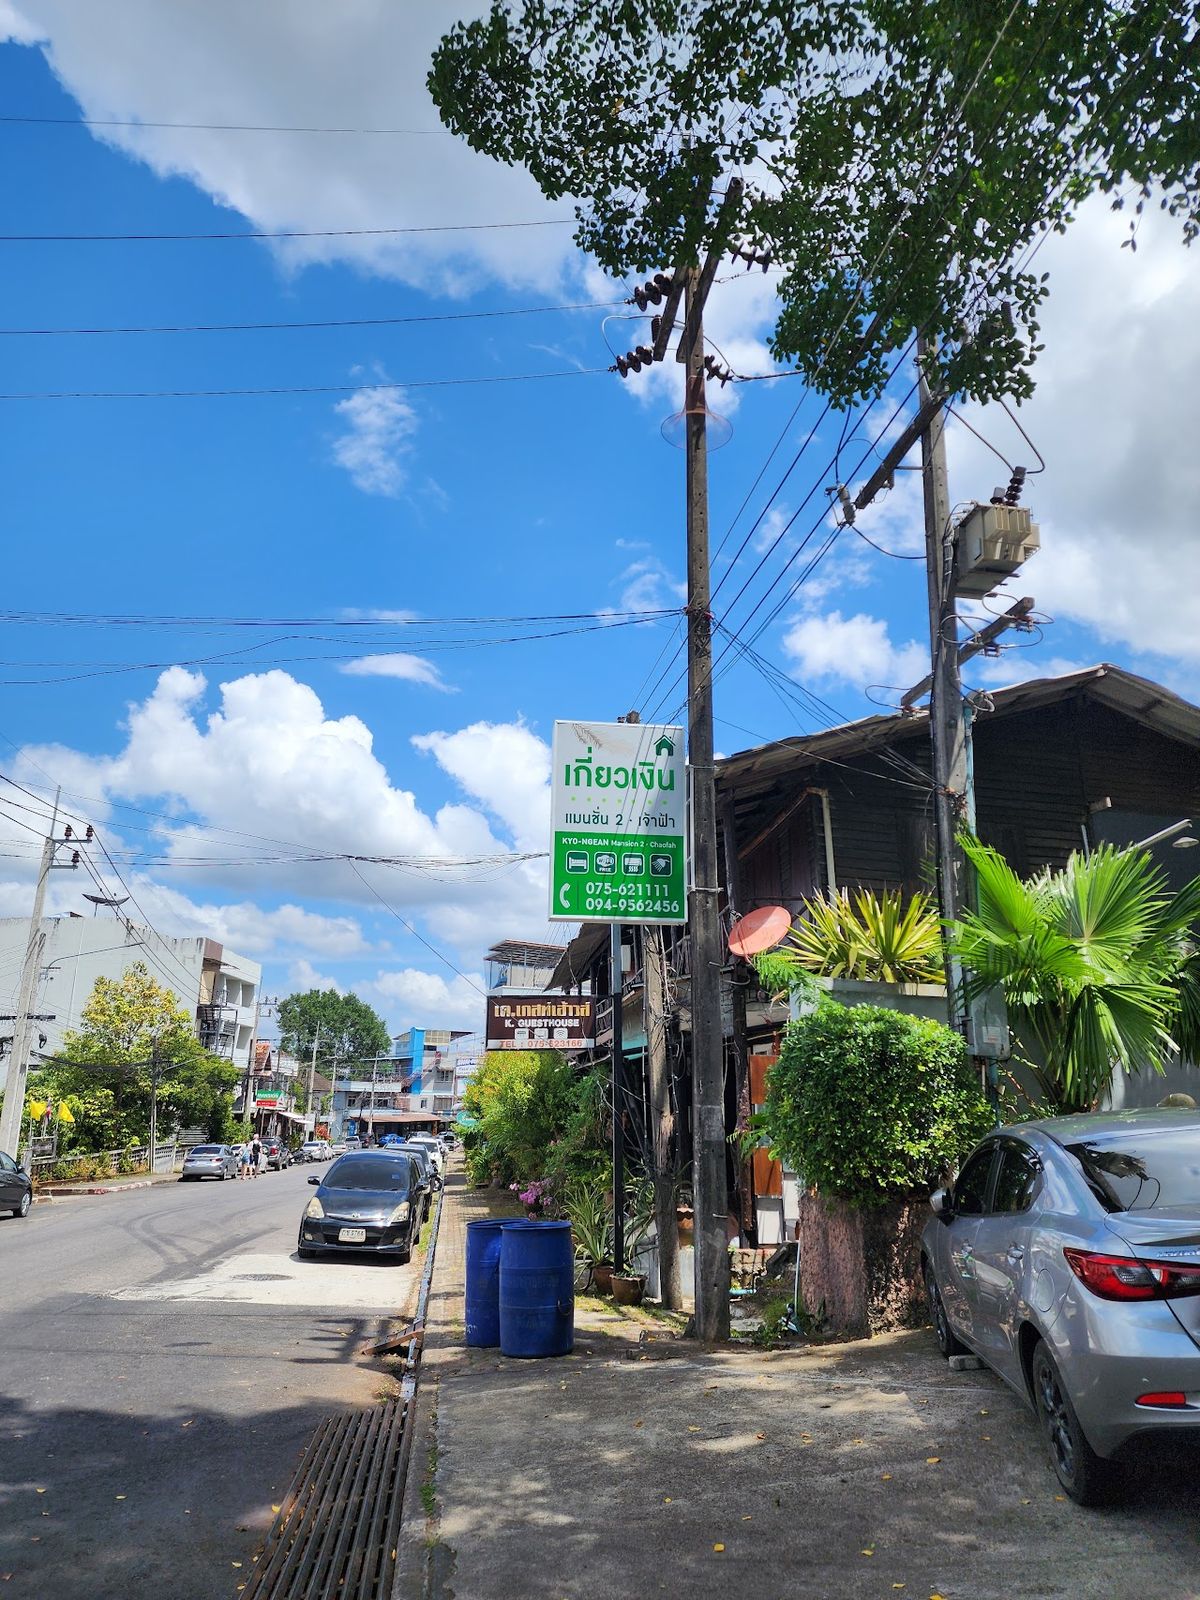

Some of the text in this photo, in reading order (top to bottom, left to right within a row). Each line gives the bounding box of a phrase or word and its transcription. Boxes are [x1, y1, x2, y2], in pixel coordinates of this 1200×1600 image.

[565, 747, 675, 791] เกี่ยวเงิน
[565, 806, 675, 828] แมนชั่น 2 เจ้าฟ้า
[562, 837, 609, 846] KYO-NGEAN
[610, 840, 639, 848] Mansion
[585, 882, 669, 897] 075-621111
[585, 898, 680, 913] 094-9562456
[517, 1019, 580, 1028] GUESTHOUSE
